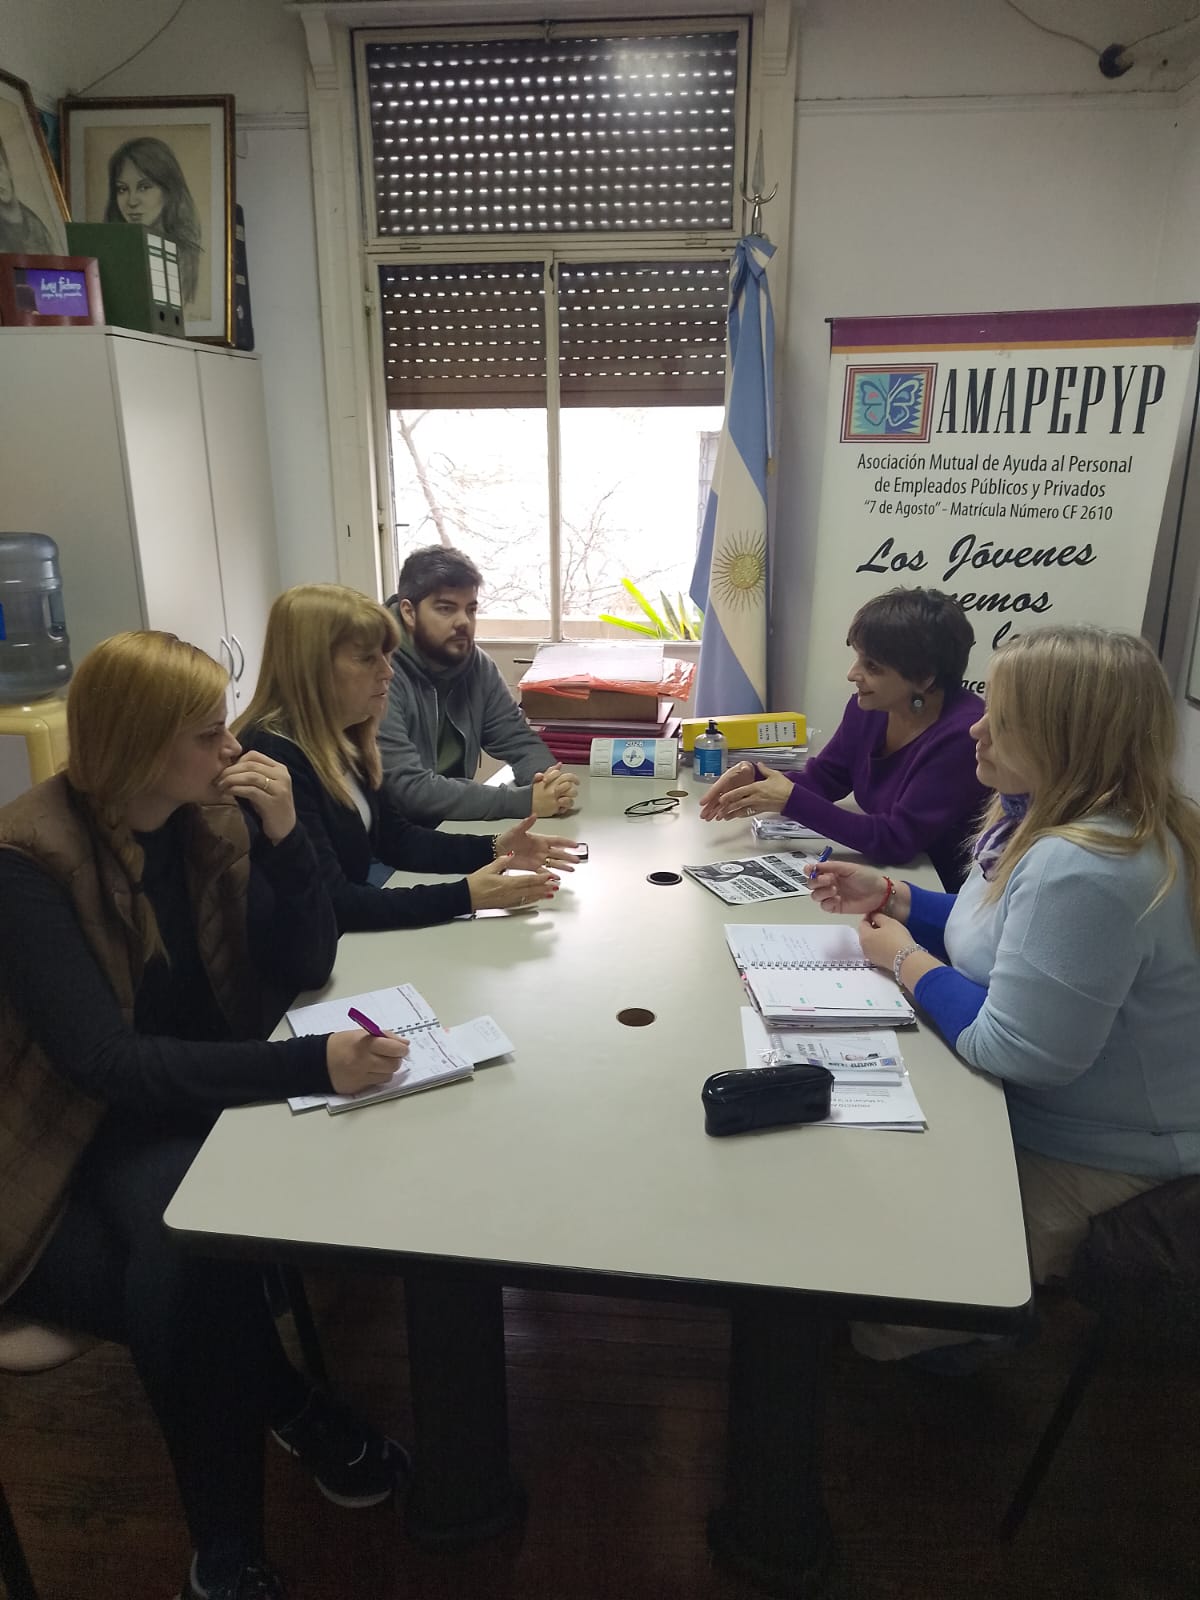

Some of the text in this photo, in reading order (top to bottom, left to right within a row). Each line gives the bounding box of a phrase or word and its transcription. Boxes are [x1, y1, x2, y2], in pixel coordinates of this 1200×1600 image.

[936, 364, 1166, 435] AMAPEPYP
[857, 453, 1133, 476] Asociación Mutual de Ayuda al Personal
[874, 476, 1106, 501] de Empleados Públicos y Privados
[879, 500, 893, 514] de
[950, 501, 1006, 517] Matrícula
[1009, 503, 1059, 519] Número
[1062, 504, 1078, 520] CF
[1080, 505, 1113, 521] 2610
[855, 534, 1097, 582] Los Jóvenes
[952, 591, 1054, 613] emos
